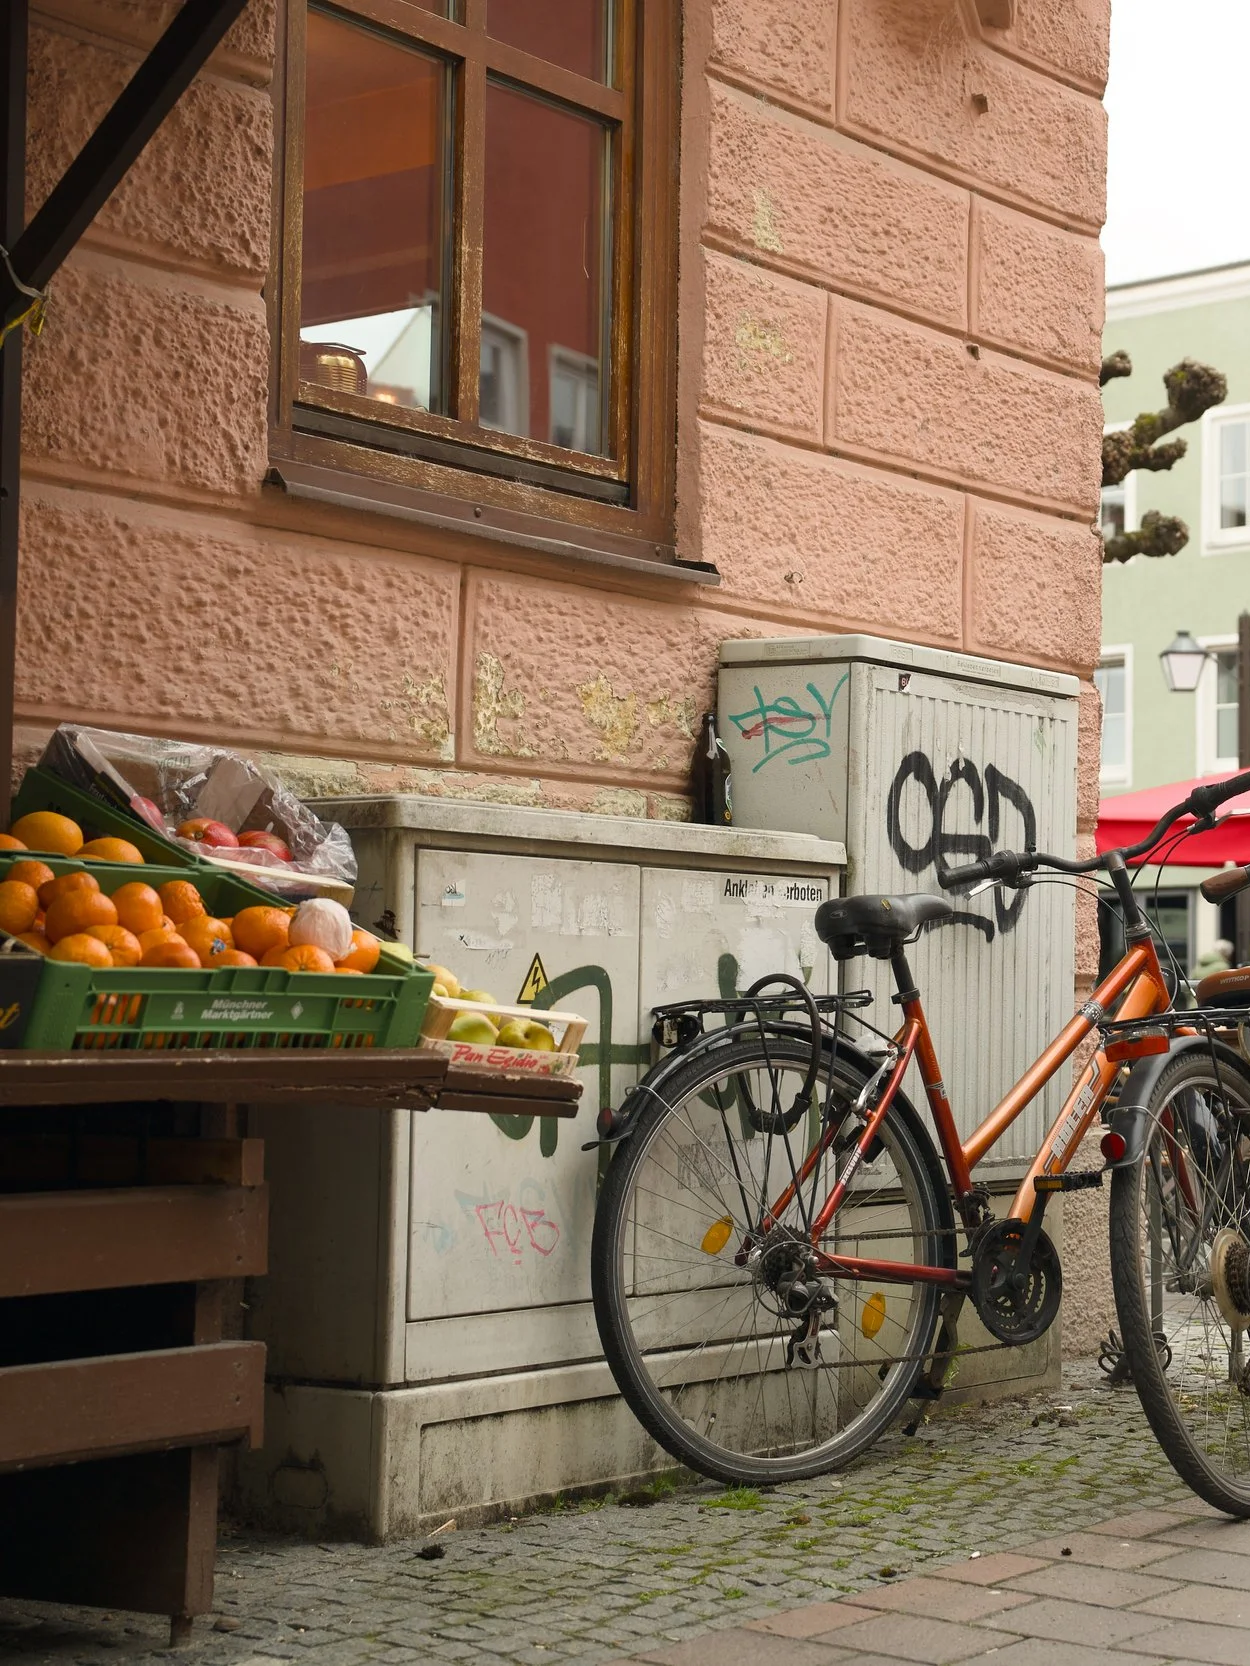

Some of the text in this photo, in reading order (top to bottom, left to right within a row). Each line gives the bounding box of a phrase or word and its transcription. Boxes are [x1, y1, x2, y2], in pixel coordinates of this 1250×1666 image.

[781, 882, 823, 902] erboten
[211, 998, 268, 1009] Münchner
[201, 1009, 274, 1021] Marktgärtner
[452, 1044, 539, 1070] Pan Egidio
[1051, 1083, 1095, 1160] ADLER
